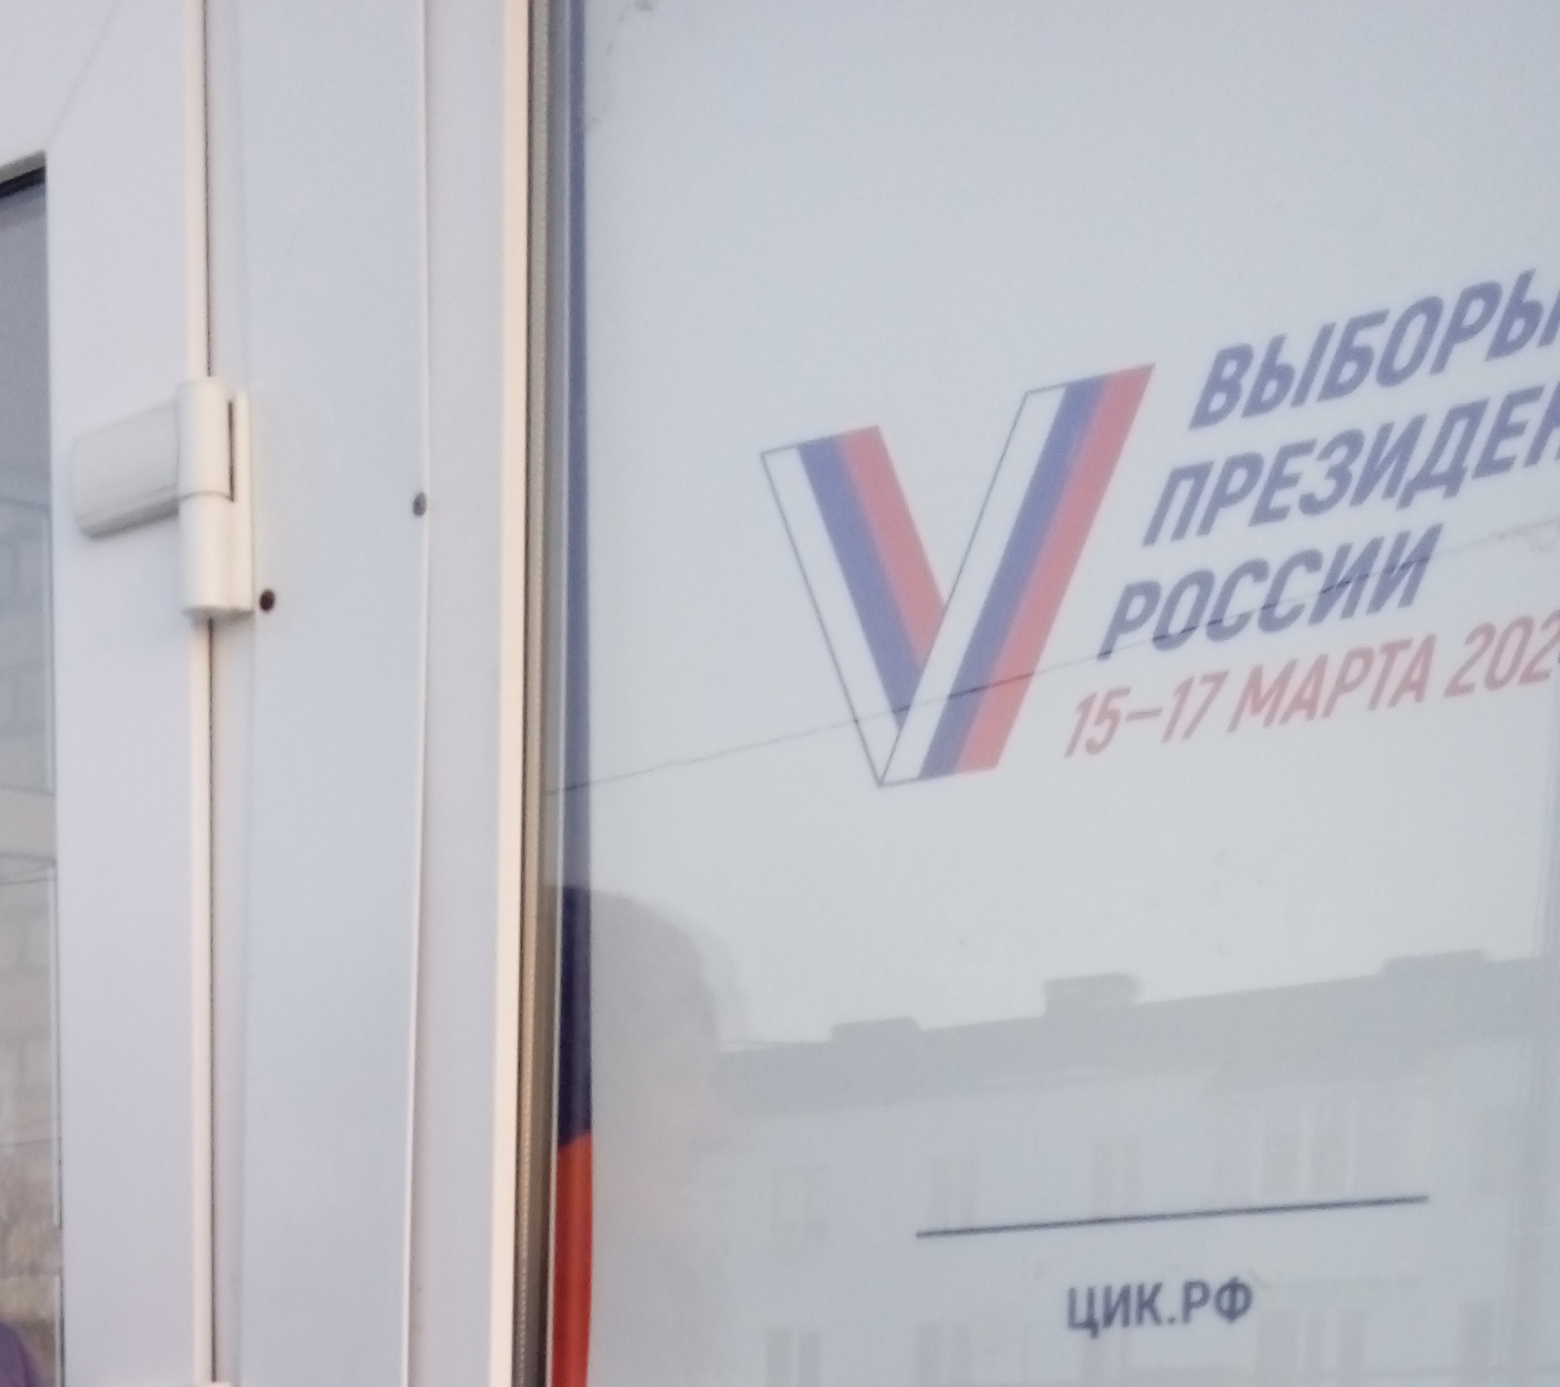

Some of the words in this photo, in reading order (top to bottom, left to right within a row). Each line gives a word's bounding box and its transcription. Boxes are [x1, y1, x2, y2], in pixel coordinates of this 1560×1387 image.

[1097, 524, 1444, 661] РОССИИ
[1228, 634, 1437, 733] МАРТА
[1444, 609, 1560, 698] 202
[1068, 1276, 1253, 1339] ЦИК.РФ
